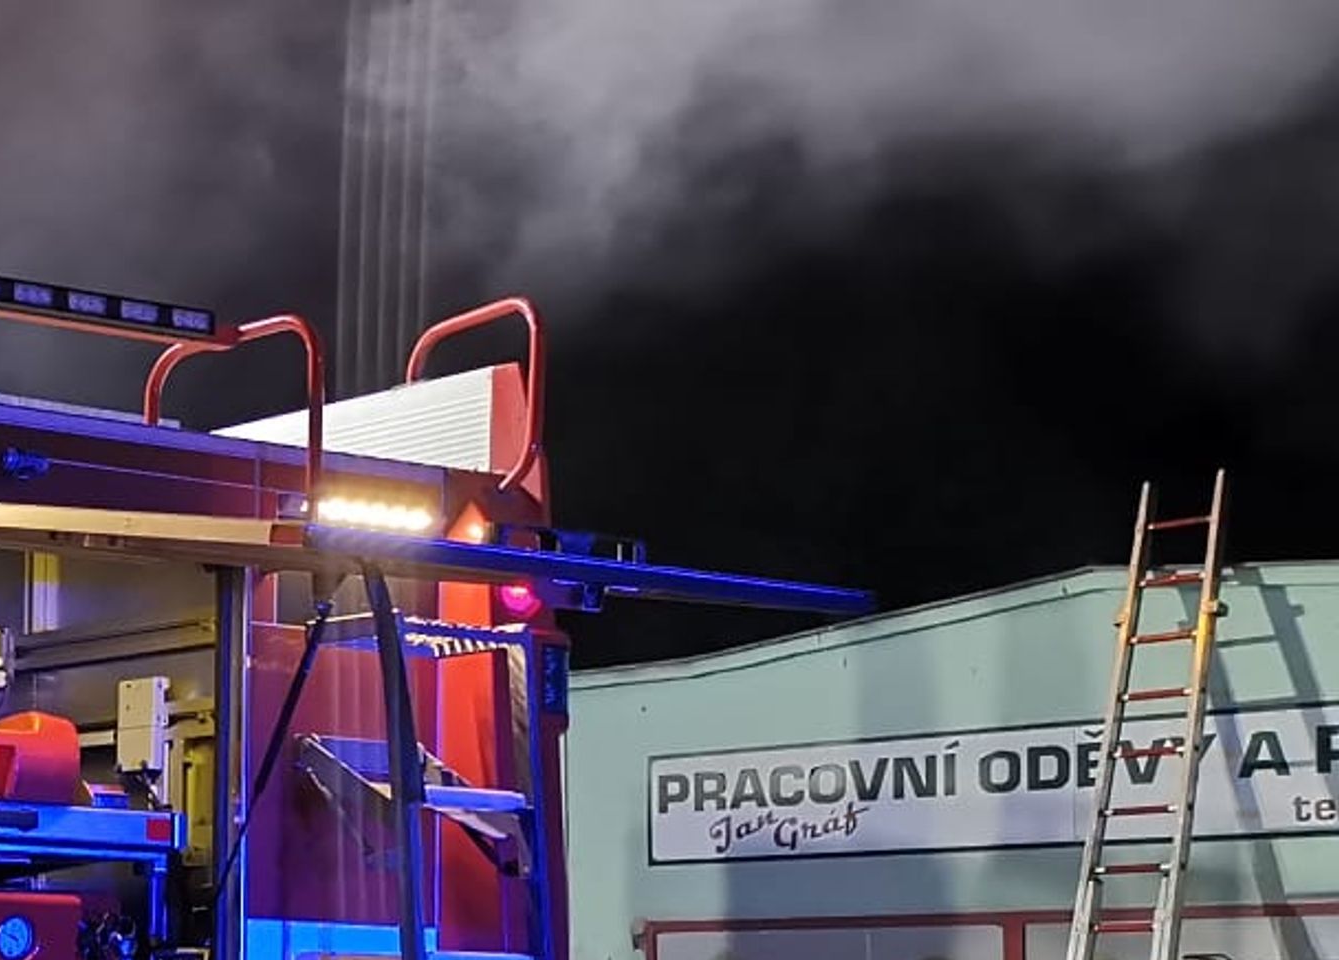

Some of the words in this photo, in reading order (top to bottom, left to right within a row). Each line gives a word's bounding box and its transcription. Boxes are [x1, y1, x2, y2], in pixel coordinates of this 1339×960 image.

[658, 741, 960, 813] PRACOVNÍ
[1237, 730, 1291, 779] A
[709, 811, 779, 853] Jan
[773, 801, 870, 850] Gráf
